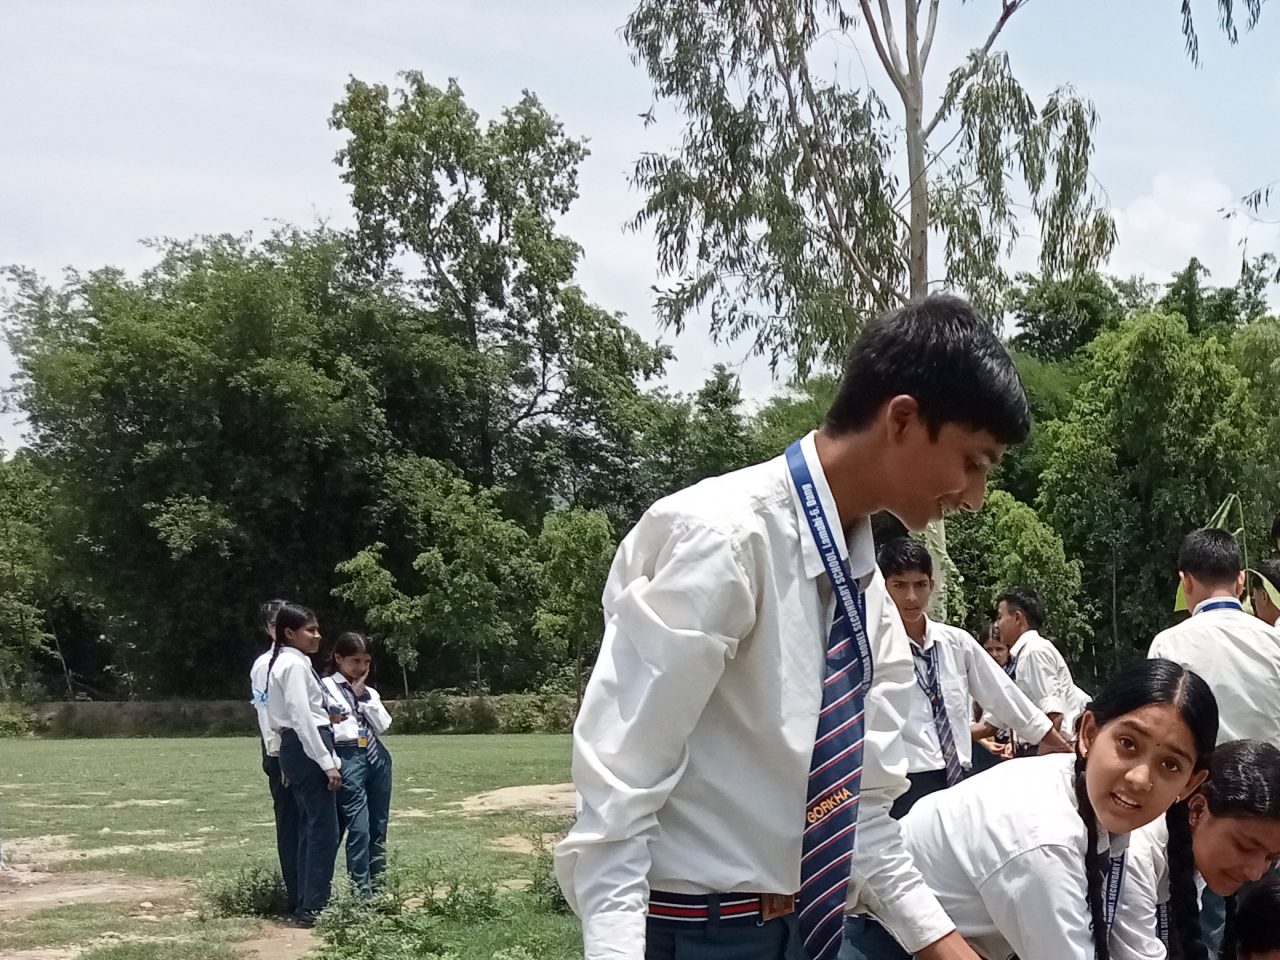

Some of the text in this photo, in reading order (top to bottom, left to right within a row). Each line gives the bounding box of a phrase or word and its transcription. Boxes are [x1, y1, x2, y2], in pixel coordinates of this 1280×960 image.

[802, 483, 817, 507] Dang
[837, 585, 863, 632] SECONDARY
[856, 630, 869, 658] MODEL
[807, 787, 854, 823] GORKHA
[1109, 862, 1122, 901] SECONDARY
